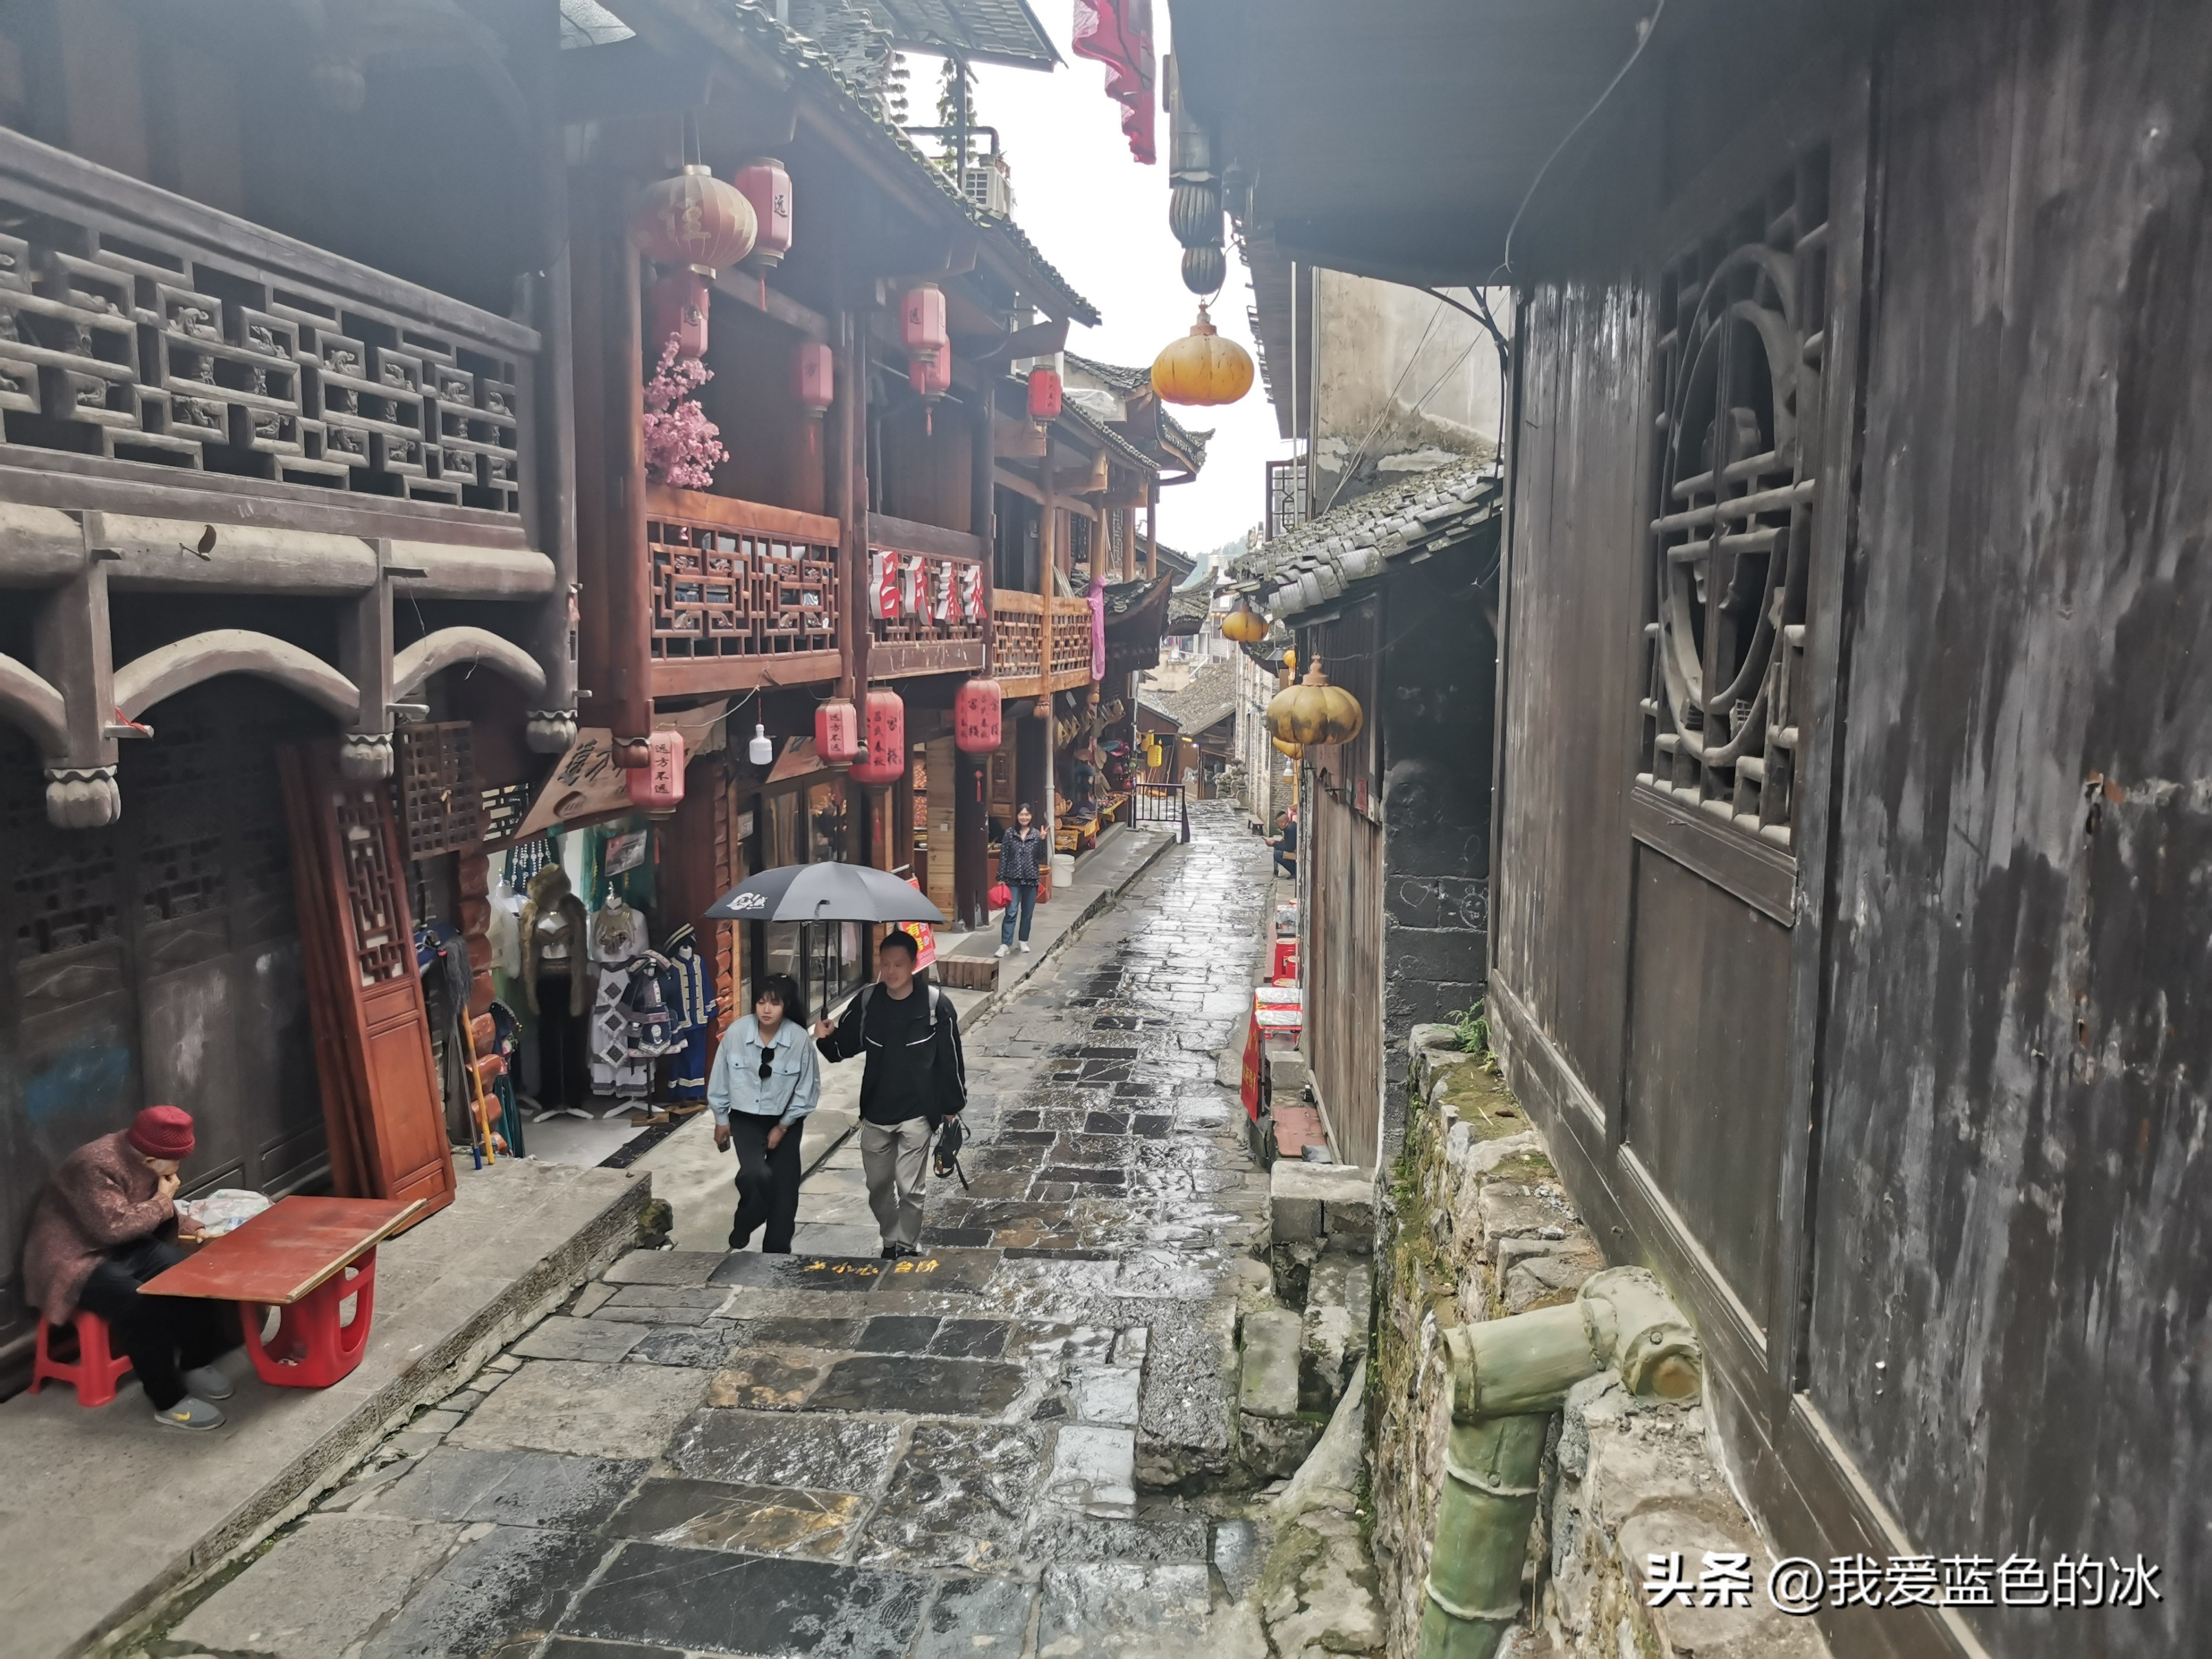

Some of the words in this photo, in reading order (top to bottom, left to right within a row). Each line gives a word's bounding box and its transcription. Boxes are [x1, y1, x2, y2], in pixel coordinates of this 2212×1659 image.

[774, 193, 787, 218] 远
[870, 551, 987, 625] 吕氏春秋
[829, 713, 841, 751] 远方不远
[873, 711, 886, 766] 吕氏春秋
[654, 744, 671, 794] 远方不远
